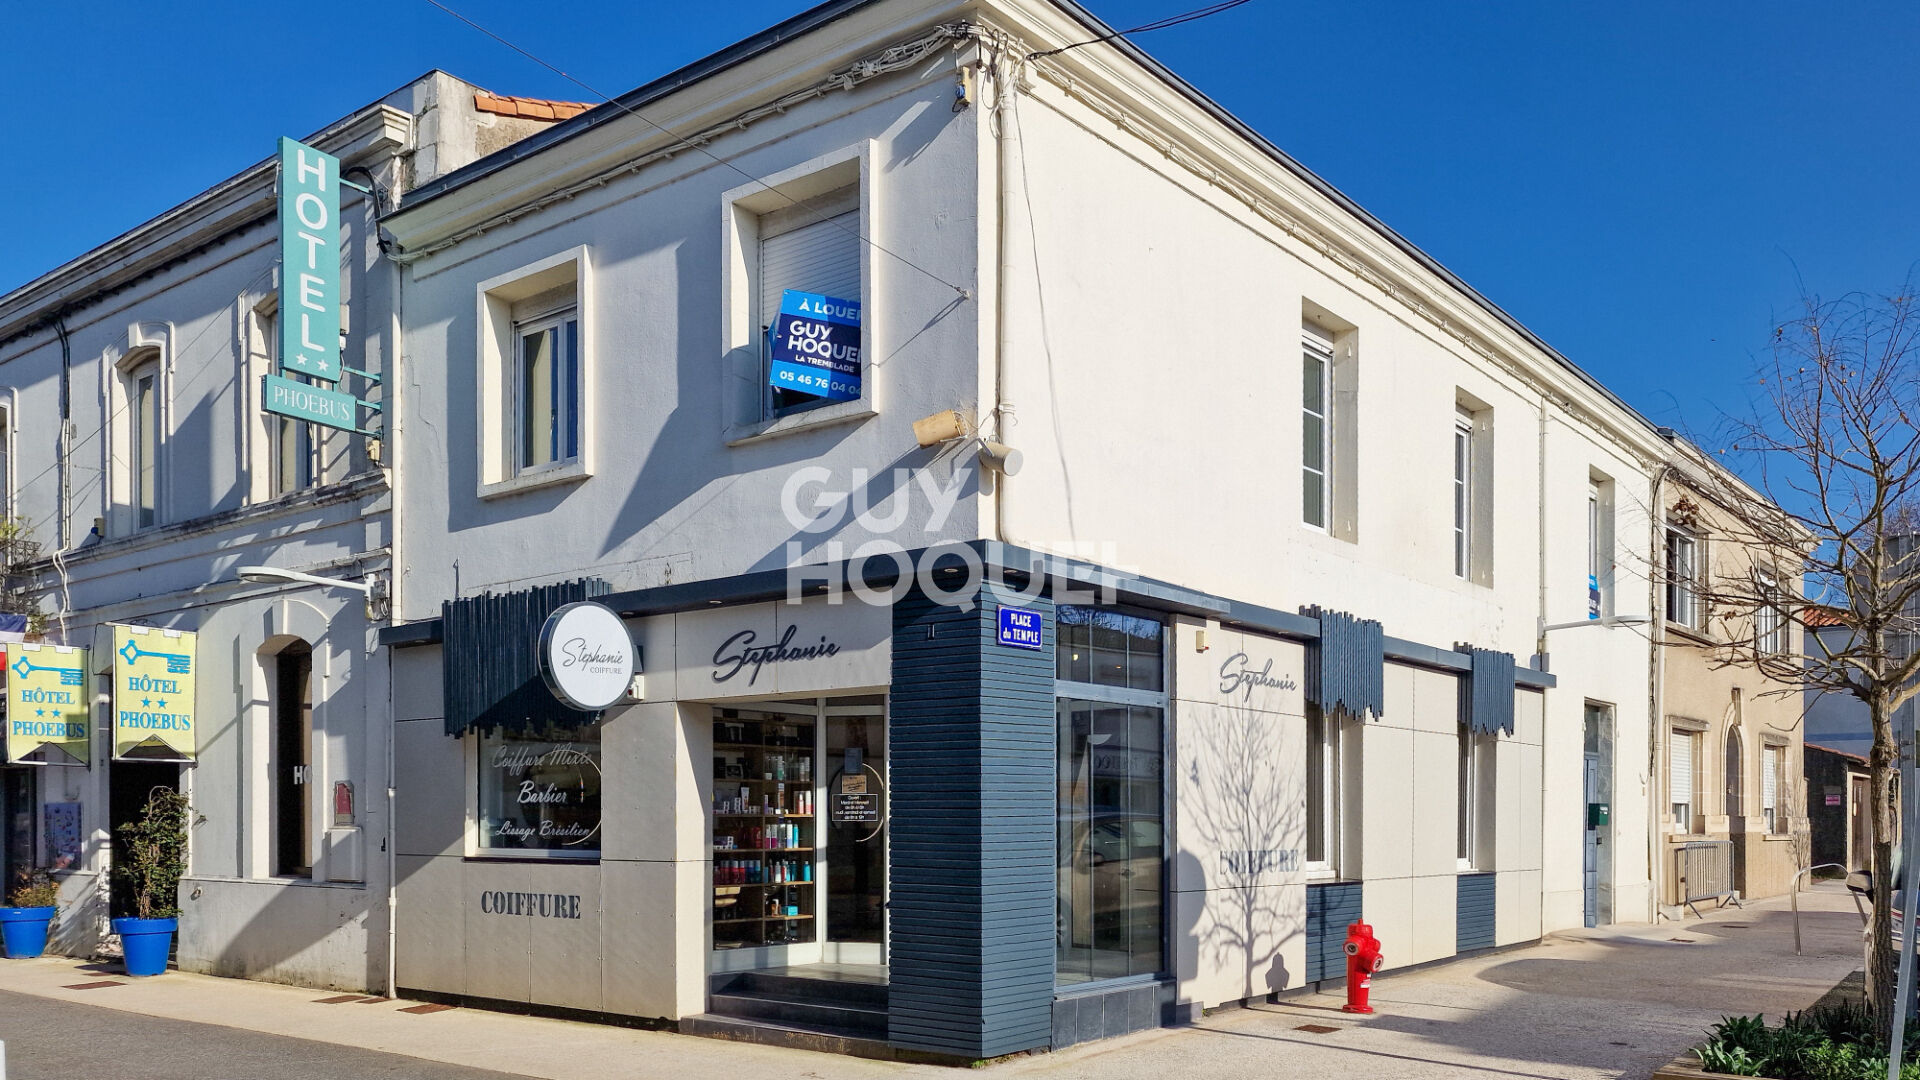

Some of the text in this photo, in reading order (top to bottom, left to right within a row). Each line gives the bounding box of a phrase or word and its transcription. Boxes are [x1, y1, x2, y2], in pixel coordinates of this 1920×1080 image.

[296, 149, 328, 352] HOTEL
[798, 298, 810, 312] À
[789, 320, 833, 340] GUY
[795, 354, 855, 373] LA TREMBLADE
[780, 371, 795, 382] 05
[797, 375, 812, 385] 46
[815, 378, 829, 389] 76
[831, 381, 845, 392] 04
[274, 385, 350, 421] PHOEBUS
[1011, 613, 1032, 628] PLACE
[1003, 627, 1039, 643] du TEMPLE
[562, 637, 624, 671] Stephanie
[712, 624, 841, 686] Stephanie
[590, 666, 623, 675] COIFFURE
[1219, 653, 1298, 703] Stephanie
[129, 674, 182, 695] HÔTEL
[21, 687, 76, 705] HÔTEL
[13, 721, 85, 738] PHOEBUS
[120, 711, 191, 731] PHOEBUS
[492, 745, 543, 776] Coiffure
[517, 780, 567, 804] Barbier
[495, 820, 536, 841] Lissage
[481, 890, 581, 919] COIFFURE
